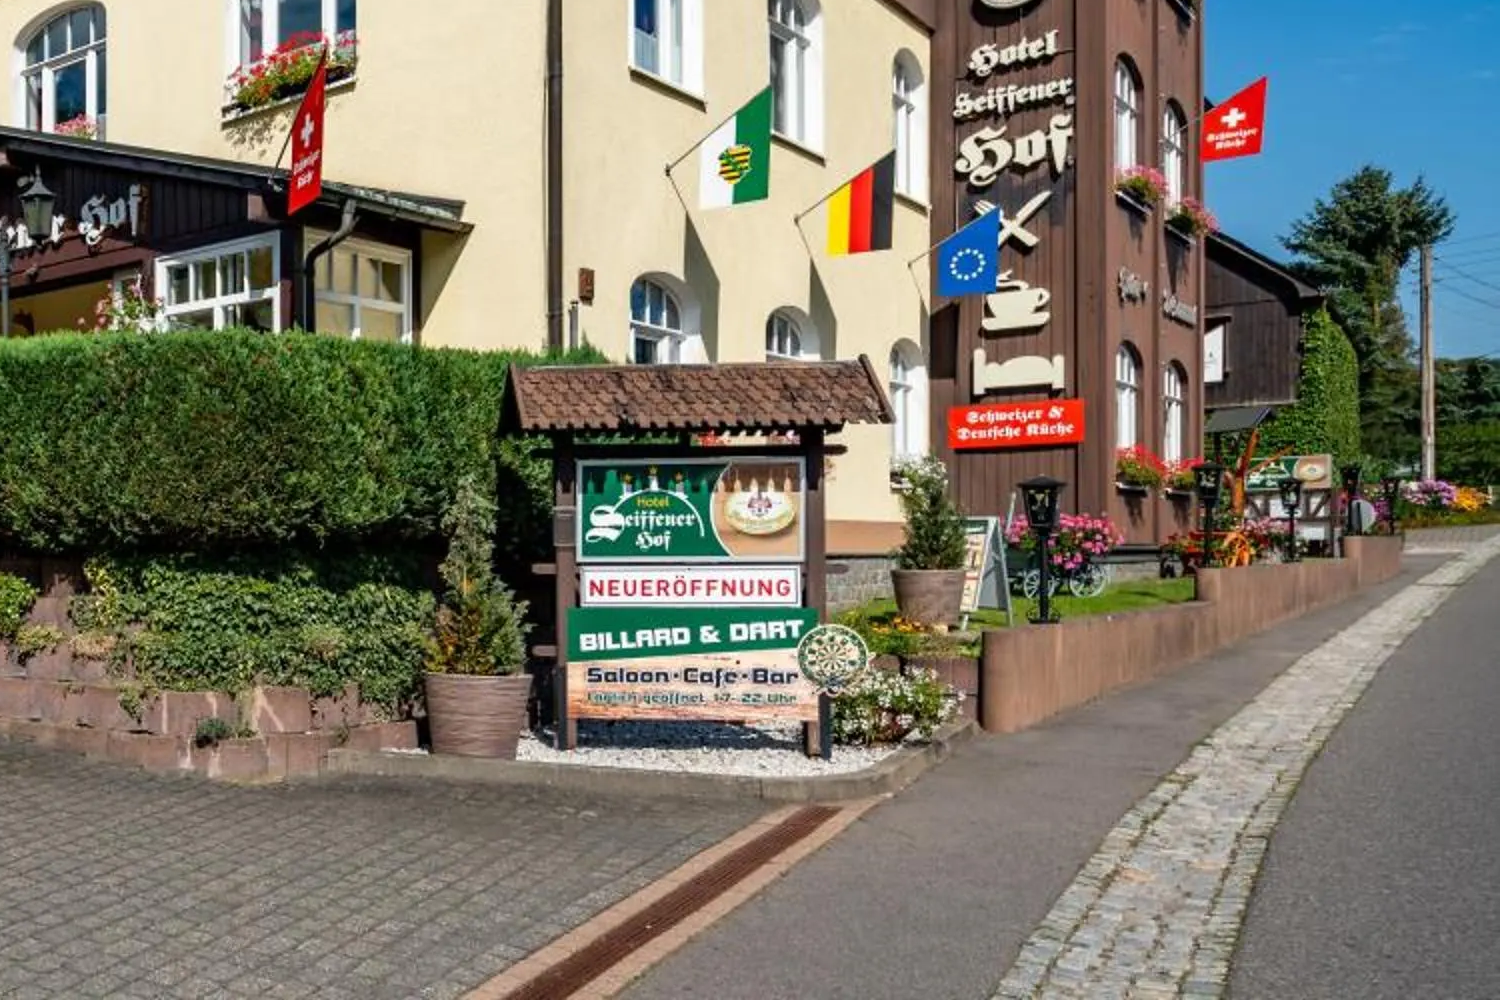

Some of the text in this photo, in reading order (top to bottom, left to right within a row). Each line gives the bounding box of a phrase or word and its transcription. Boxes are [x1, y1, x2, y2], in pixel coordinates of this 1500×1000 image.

[969, 29, 1059, 77] Hotel
[953, 77, 1073, 119] Seiffener
[955, 113, 1074, 187] Hof
[78, 183, 143, 246] Hof
[965, 405, 1065, 424] Schweizer &
[636, 496, 670, 508] Hotel
[585, 505, 697, 543] Seiffener
[635, 530, 672, 551] Hof
[589, 575, 791, 597] NEUERÖFFNUNG
[579, 619, 804, 652] BILLARD & DART
[587, 667, 669, 684] Saloon
[752, 667, 799, 684] Bar
